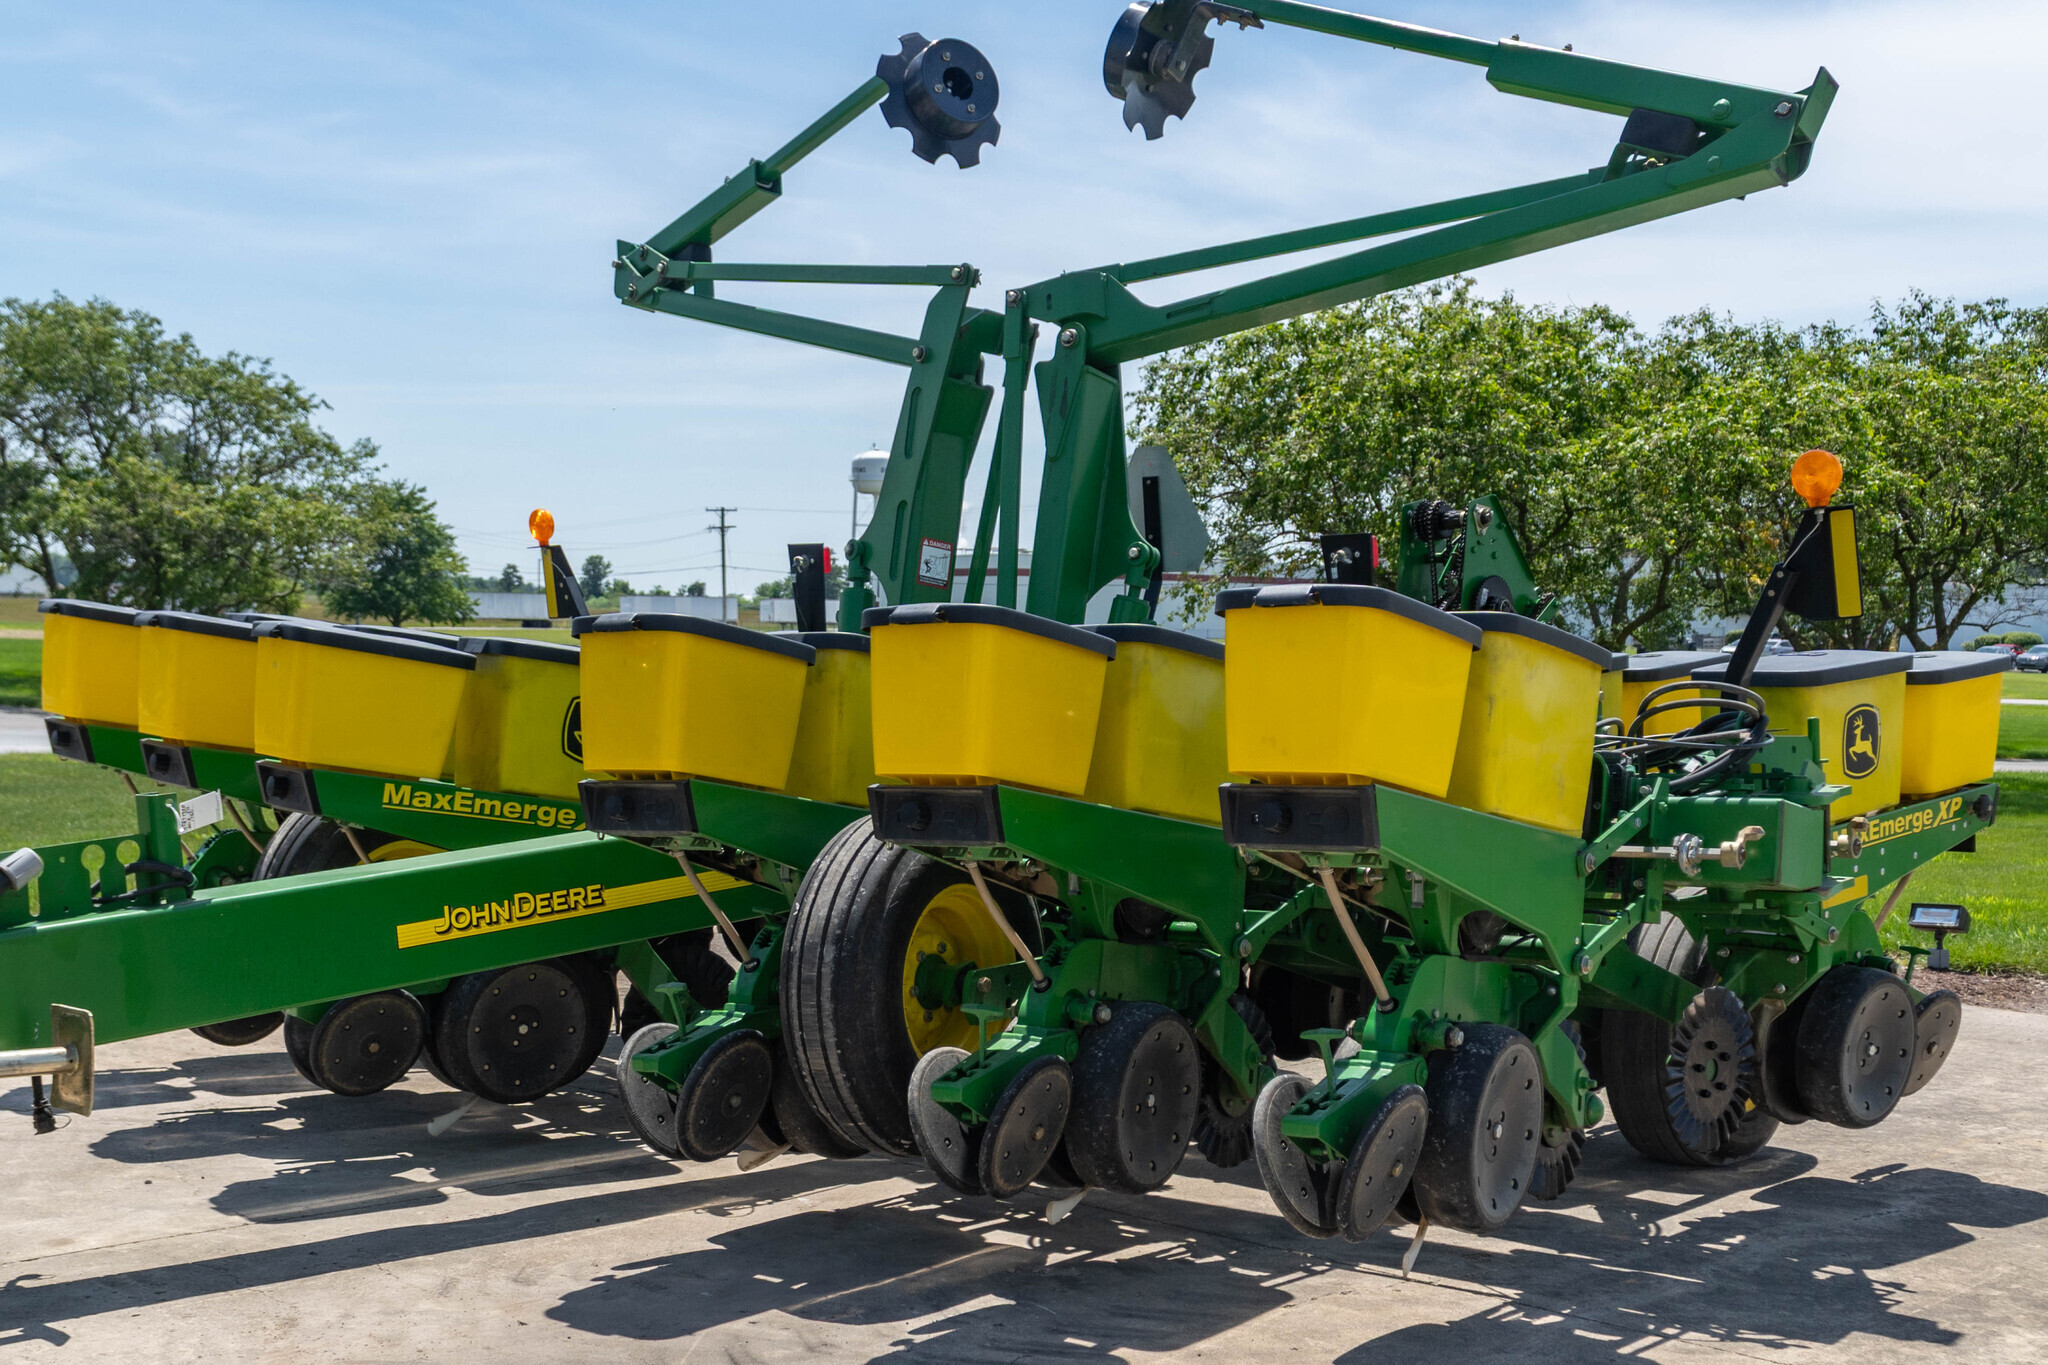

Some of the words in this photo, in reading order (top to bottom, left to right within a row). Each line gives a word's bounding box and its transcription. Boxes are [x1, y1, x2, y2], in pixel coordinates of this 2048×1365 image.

[929, 540, 952, 550] DANGER
[382, 782, 577, 828] MaxEmerge
[1832, 808, 1934, 844] xEmerge
[1932, 796, 1963, 828] XP
[434, 899, 512, 935] JOHN
[513, 884, 604, 920] DEERE
